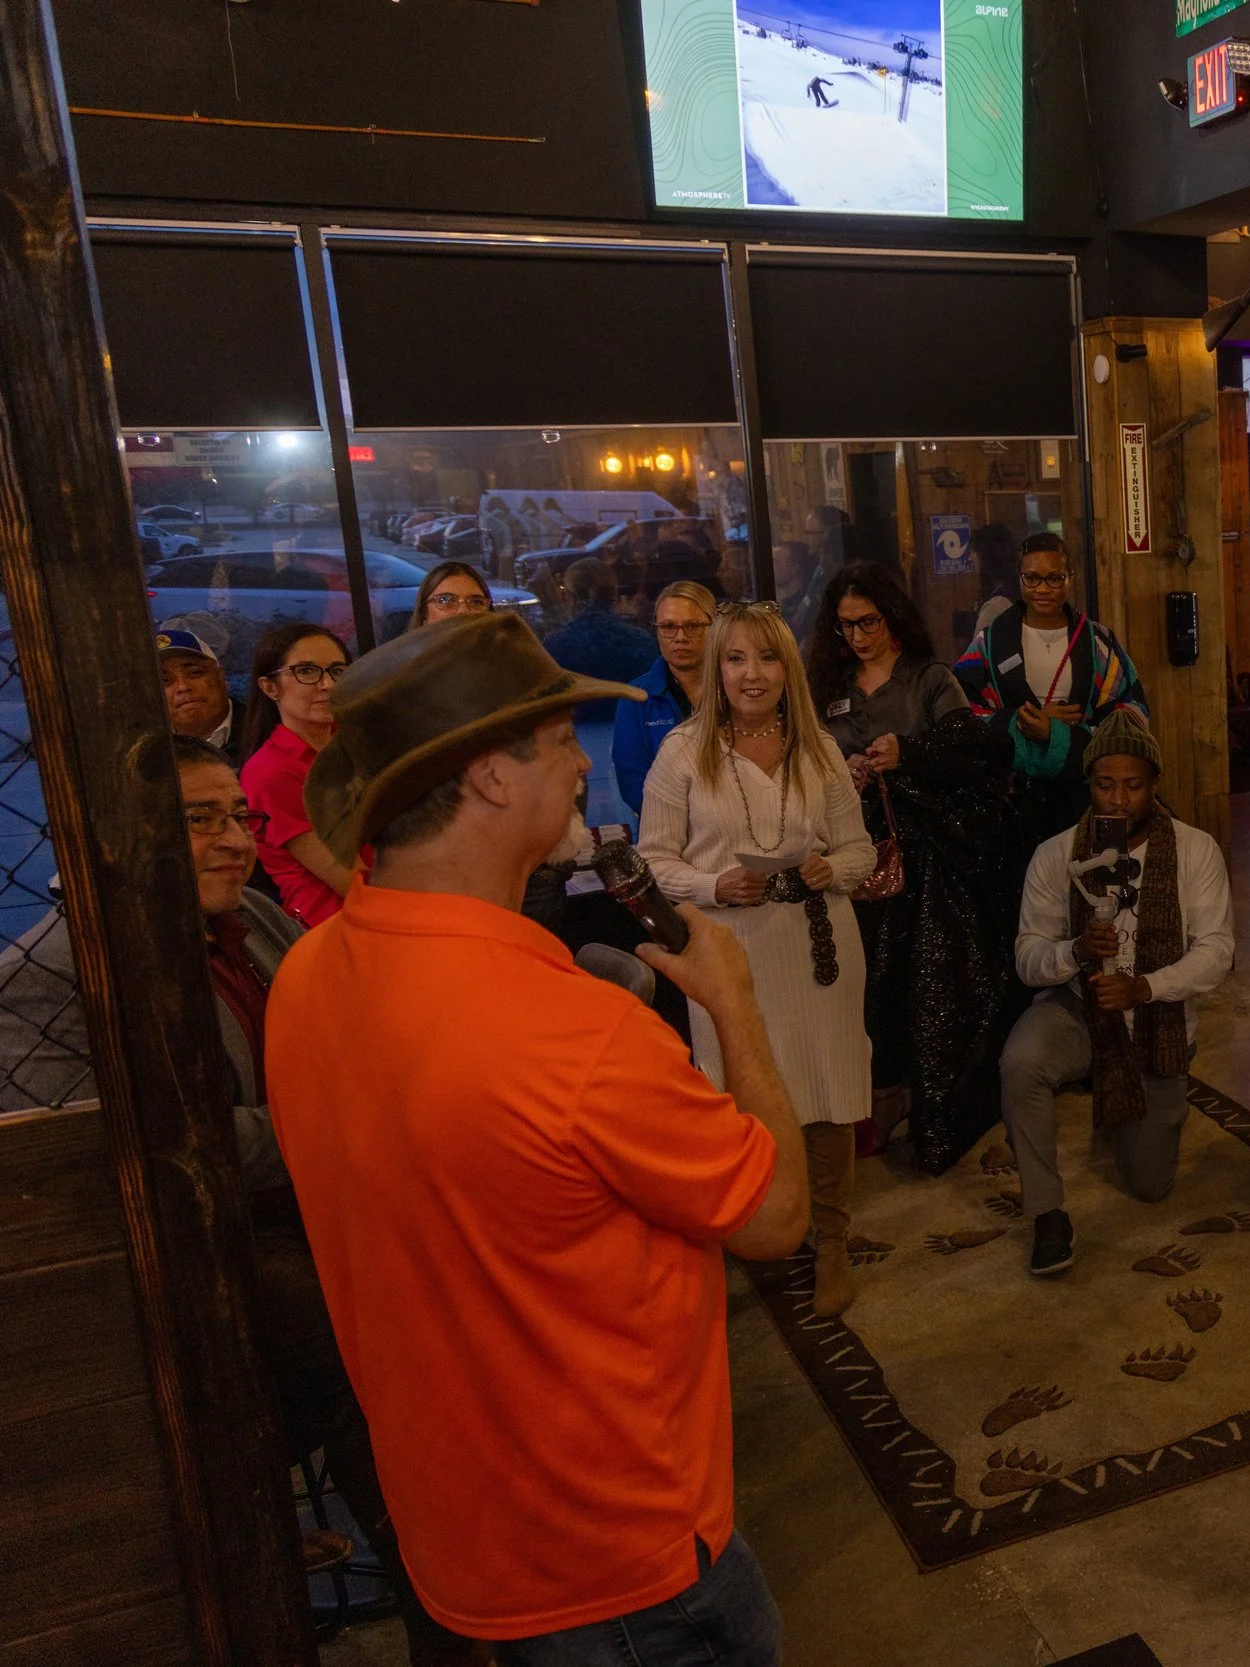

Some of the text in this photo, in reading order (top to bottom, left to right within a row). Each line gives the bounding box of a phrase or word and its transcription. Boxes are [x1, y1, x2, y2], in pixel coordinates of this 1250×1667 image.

[1193, 43, 1228, 115] EXIT
[1124, 432, 1143, 445] FIRE
[1131, 446, 1142, 539] EXTINGUISHER
